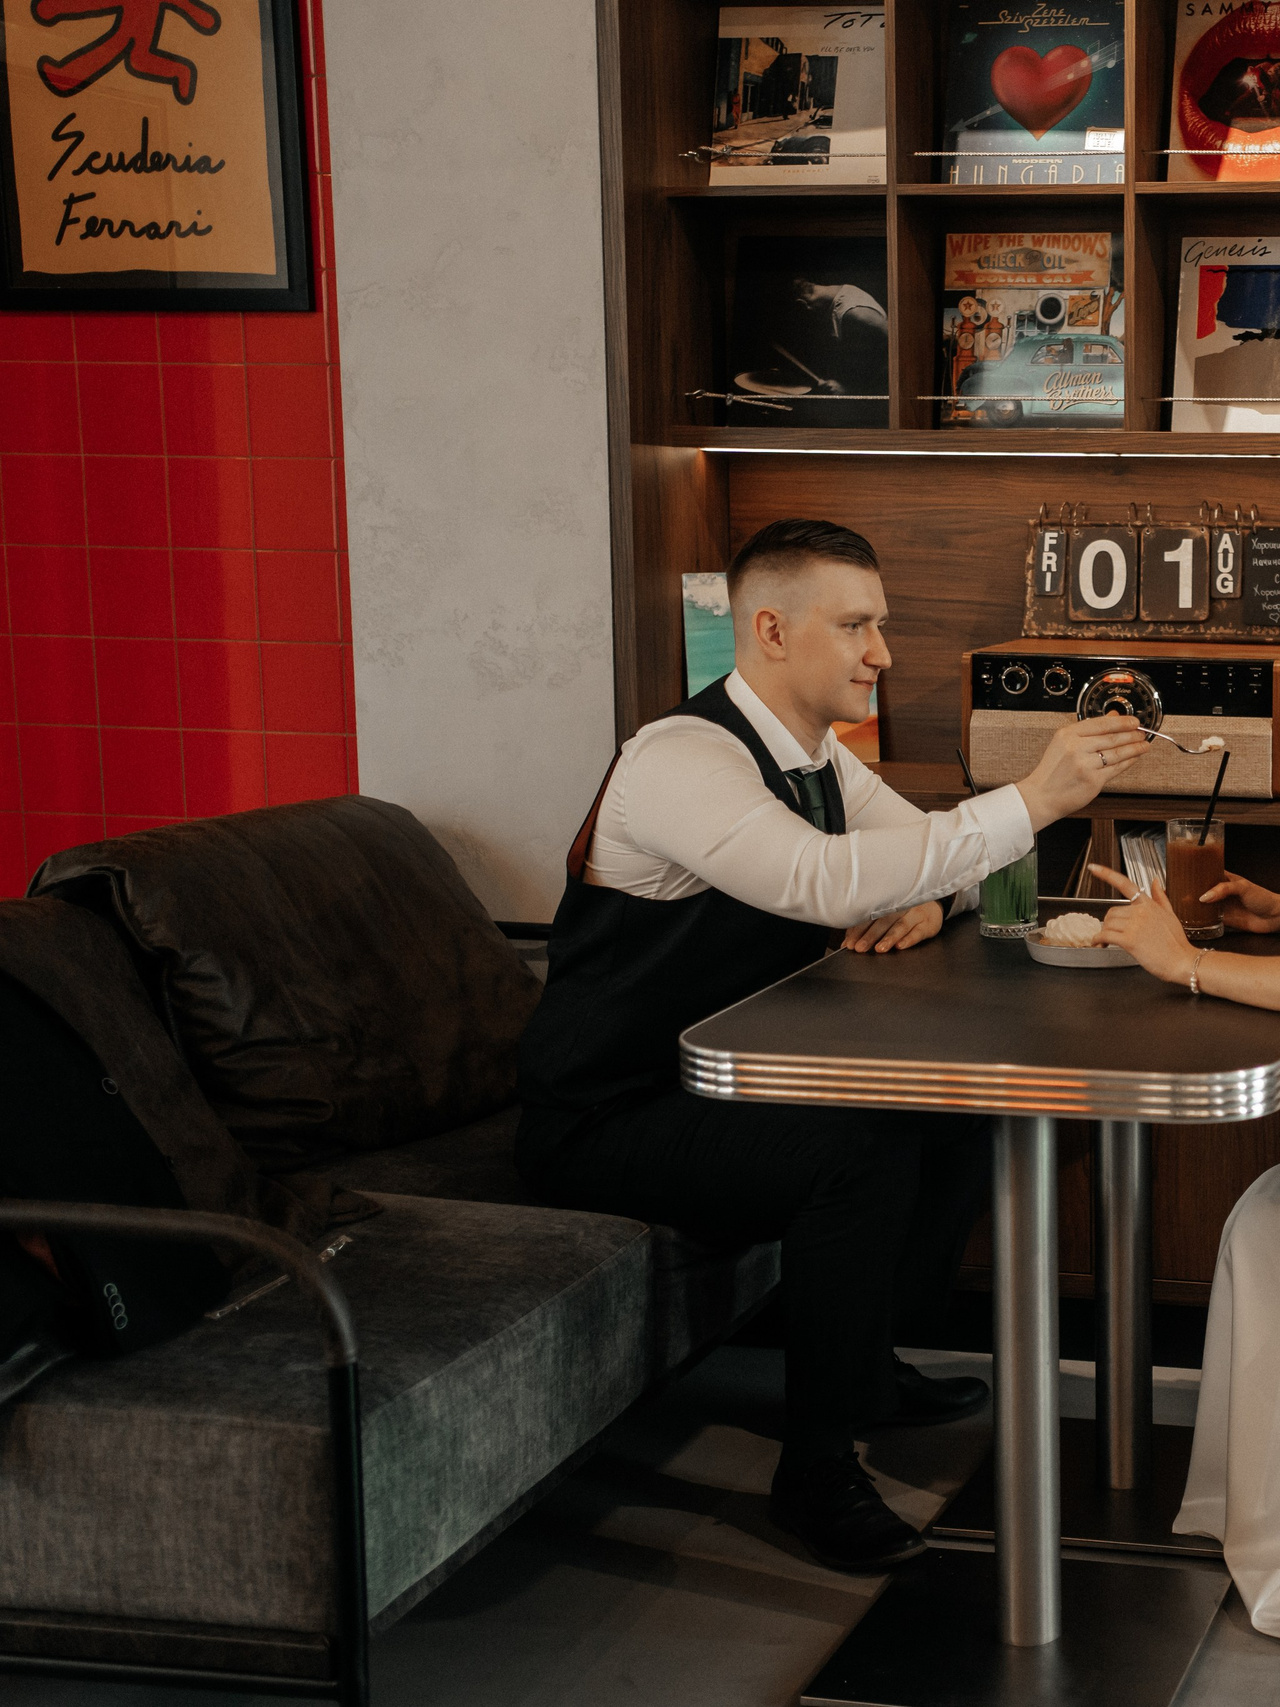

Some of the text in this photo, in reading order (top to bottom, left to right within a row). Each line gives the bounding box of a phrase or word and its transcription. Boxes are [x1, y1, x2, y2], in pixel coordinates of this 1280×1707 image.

[1032, 3, 1067, 17] Zene
[1186, 1, 1270, 16] SAMMY
[1018, 14, 1091, 33] Szerelem
[47, 112, 226, 181] Scuderia
[55, 192, 213, 246] Ferrari
[949, 234, 990, 258] WIPE
[999, 234, 1024, 248] THE
[1031, 234, 1109, 259] WINDOWS
[1183, 238, 1272, 267] Genesis
[977, 253, 1025, 270] CHECK
[1042, 253, 1067, 270] OIL
[975, 274, 1072, 284] DOLLAR GAS
[1043, 370, 1103, 394] Allman
[1048, 385, 1117, 411] Brothers
[1041, 532, 1059, 592] FRI
[1216, 533, 1235, 594] AUG
